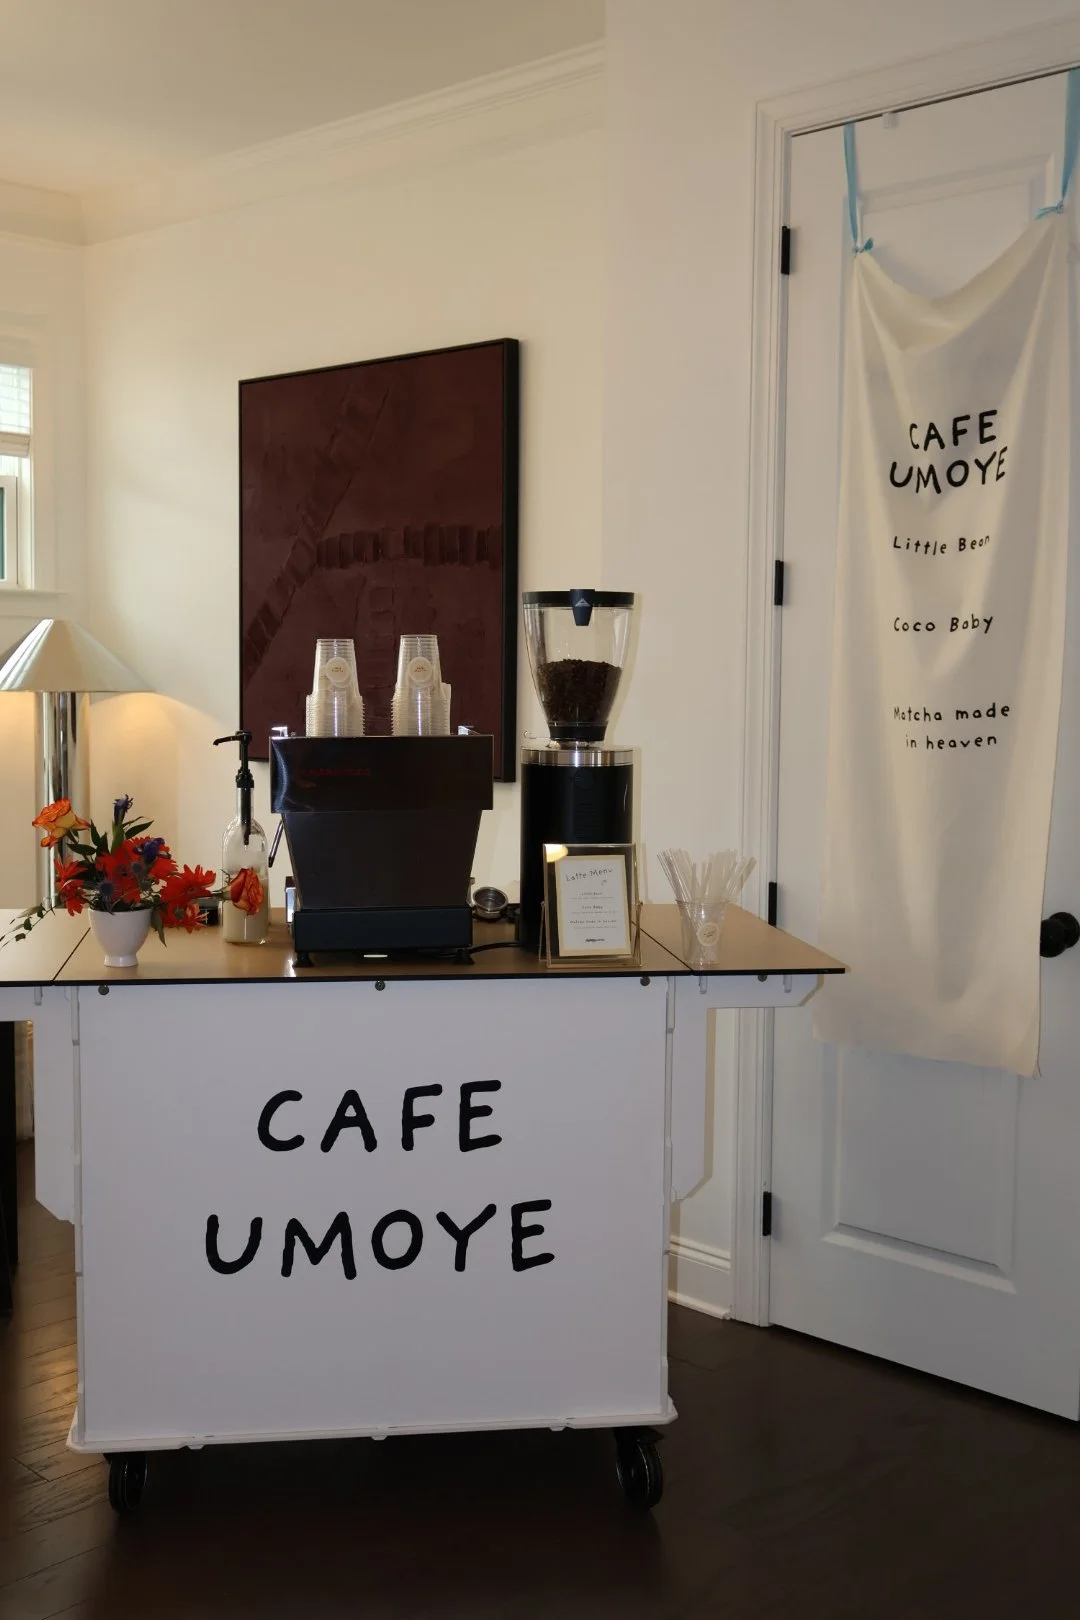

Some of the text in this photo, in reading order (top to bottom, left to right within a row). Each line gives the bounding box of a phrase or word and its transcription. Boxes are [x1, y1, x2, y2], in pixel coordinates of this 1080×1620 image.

[909, 410, 998, 451] CAFE
[890, 446, 1008, 494] UMOYE
[892, 535, 990, 556] Little Bean
[893, 613, 994, 635] Coco Baby
[894, 701, 1010, 722] Matcha made
[906, 734, 998, 750] in heaven
[565, 868, 613, 882] Latte Menu
[258, 1080, 502, 1152] CAFE
[206, 1199, 555, 1280] UMOYE
